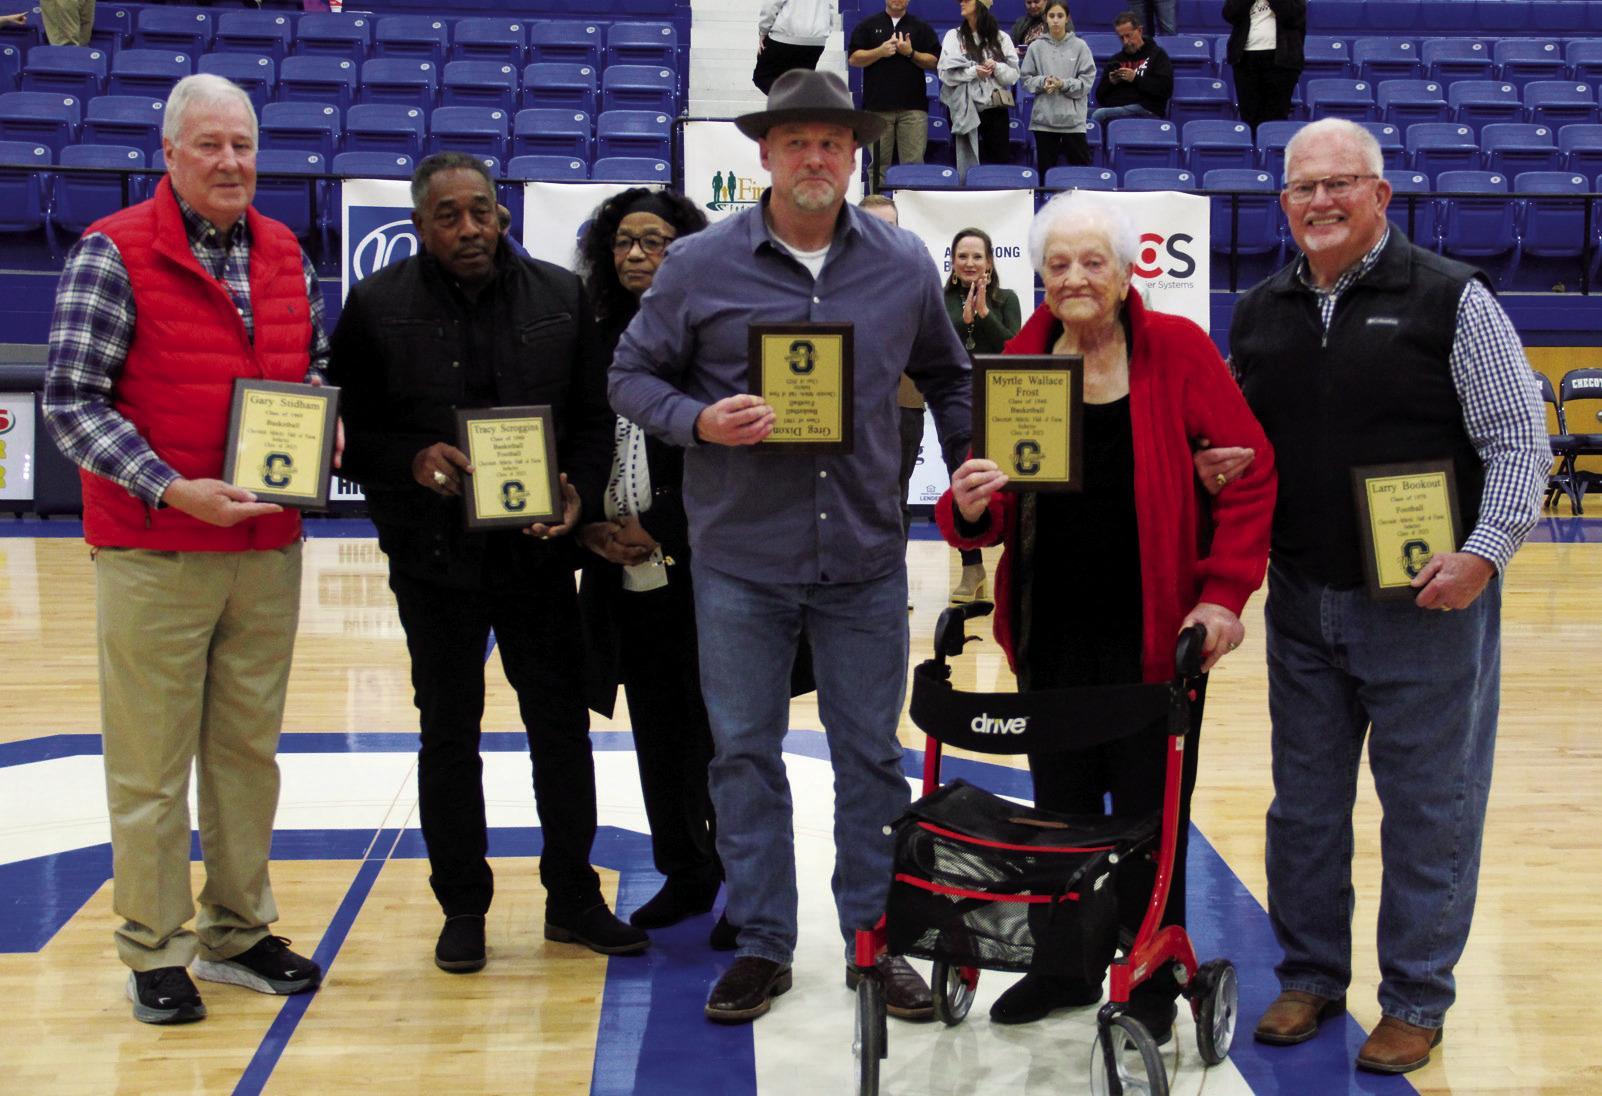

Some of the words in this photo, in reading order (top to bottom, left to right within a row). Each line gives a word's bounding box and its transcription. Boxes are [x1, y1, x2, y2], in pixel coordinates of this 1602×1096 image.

[738, 177, 764, 200] Fir
[1158, 281, 1194, 290] Systems
[992, 376, 1023, 387] Myrtle
[1028, 376, 1064, 385] Wallace
[1016, 387, 1040, 397] Frost
[250, 396, 274, 407] Gary
[280, 398, 320, 410] Stidham
[474, 425, 497, 435] Tracy
[500, 423, 540, 435] Scroggins
[773, 426, 802, 437] Dixon
[807, 425, 831, 437] Greg
[1372, 483, 1397, 494] Larry
[1402, 480, 1442, 491] Bookout
[1395, 505, 1424, 513] Football
[971, 713, 1026, 734] drive
